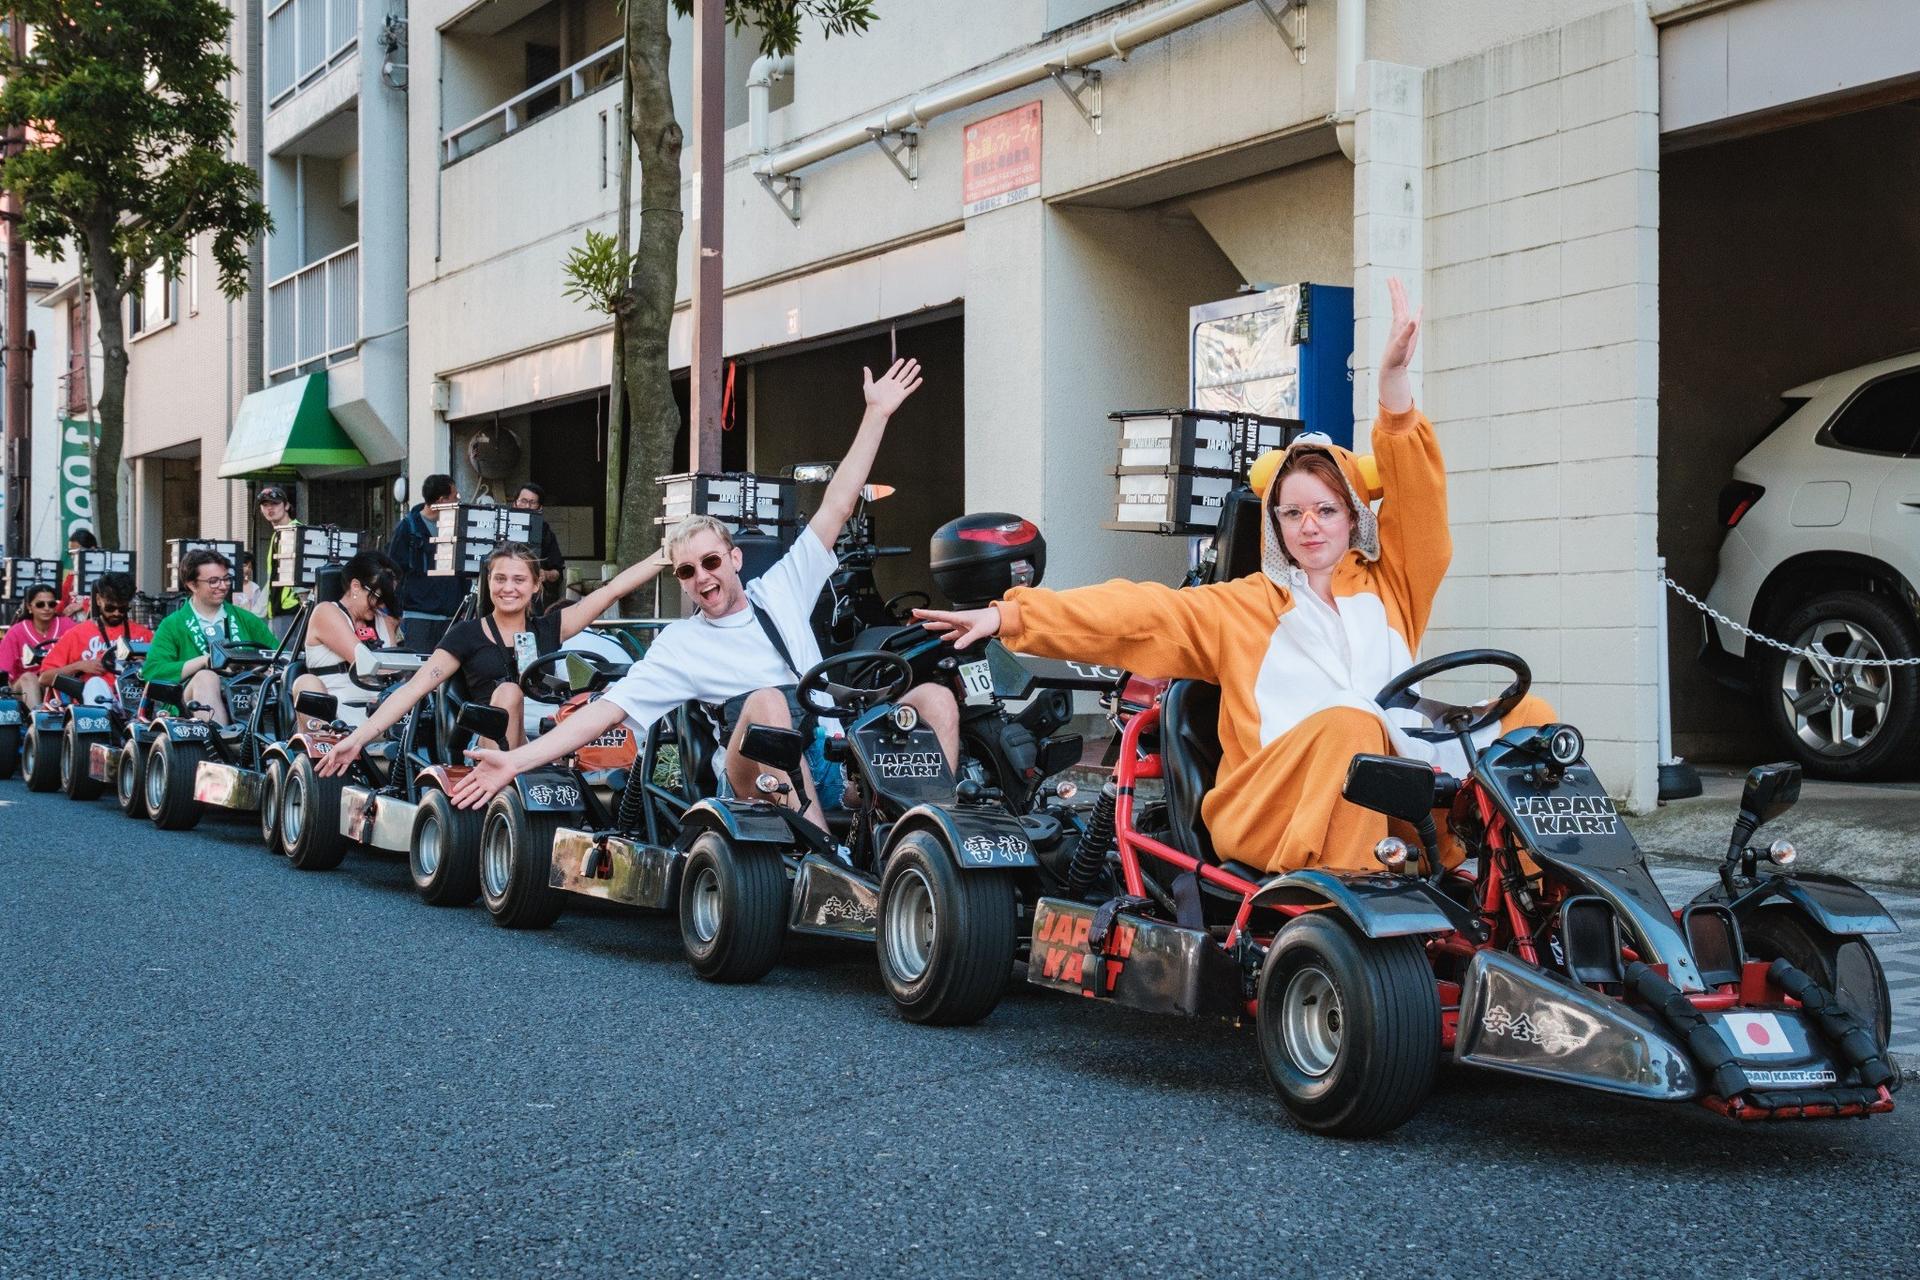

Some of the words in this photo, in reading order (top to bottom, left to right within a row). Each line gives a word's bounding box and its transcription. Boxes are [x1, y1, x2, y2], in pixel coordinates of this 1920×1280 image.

[872, 752, 943, 766] JAPAN
[882, 764, 941, 779] KART
[528, 784, 580, 807] 雷神
[1514, 796, 1617, 816] JAPAN
[1532, 815, 1618, 836] KART
[963, 834, 1028, 864] 雷神
[1038, 911, 1137, 959] JAPN
[1042, 947, 1125, 998] KAT
